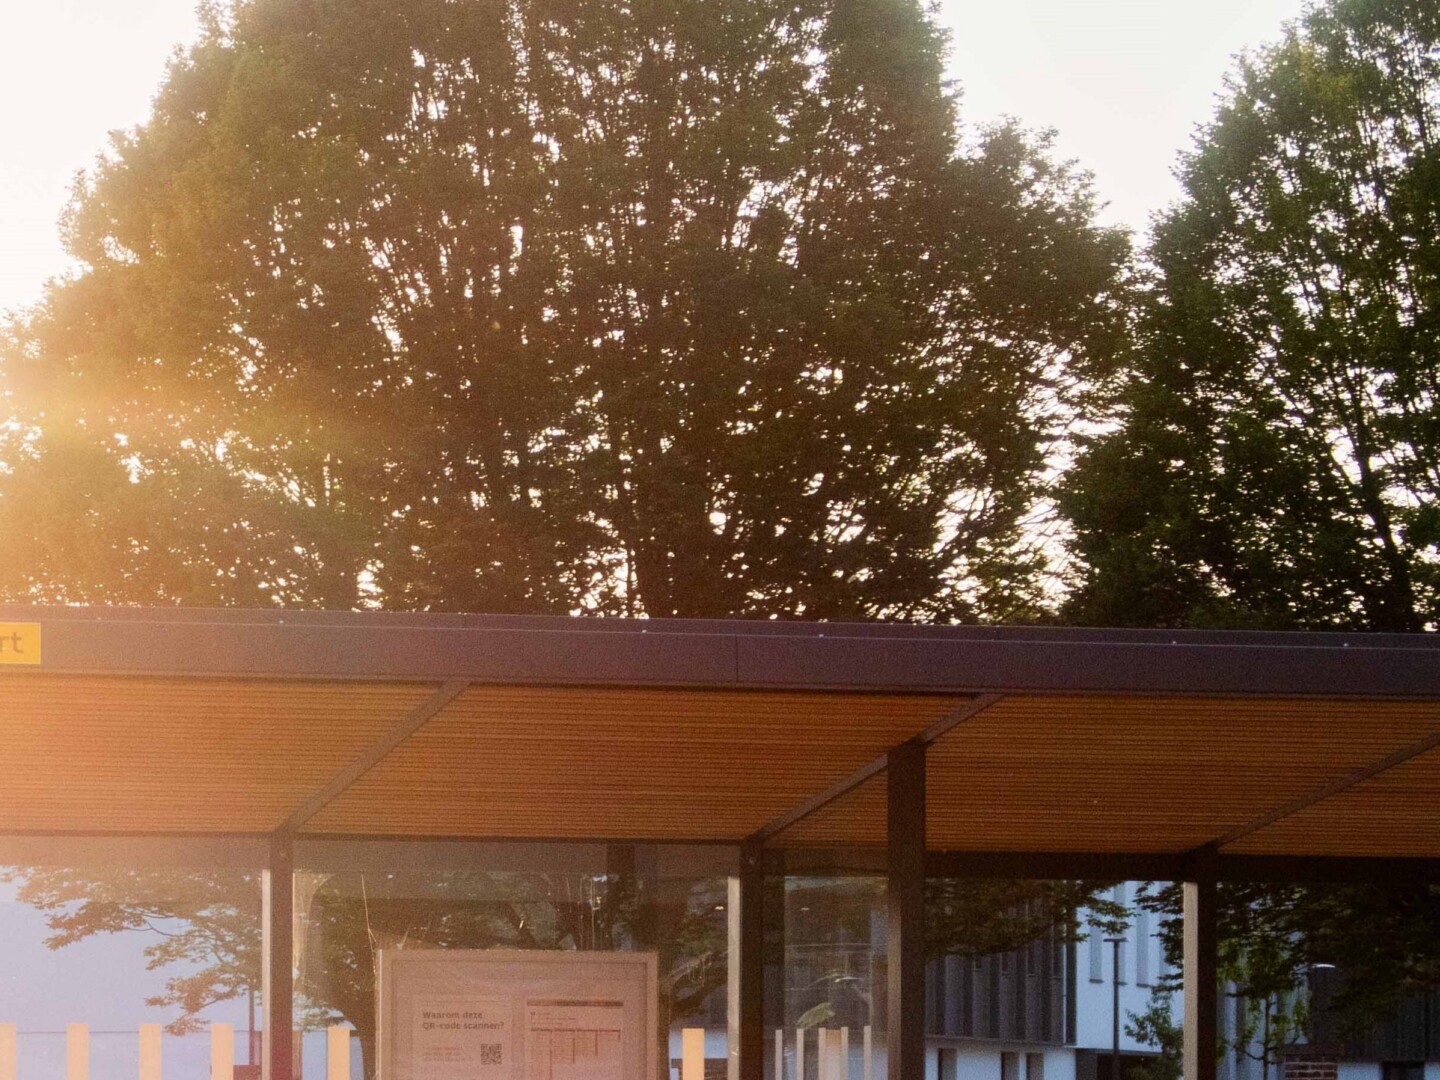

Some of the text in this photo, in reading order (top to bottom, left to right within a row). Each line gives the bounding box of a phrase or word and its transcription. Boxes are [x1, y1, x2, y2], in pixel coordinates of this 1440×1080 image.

[422, 1011, 483, 1019] Waarom deze
[422, 1021, 505, 1031] QR-code scannen?
